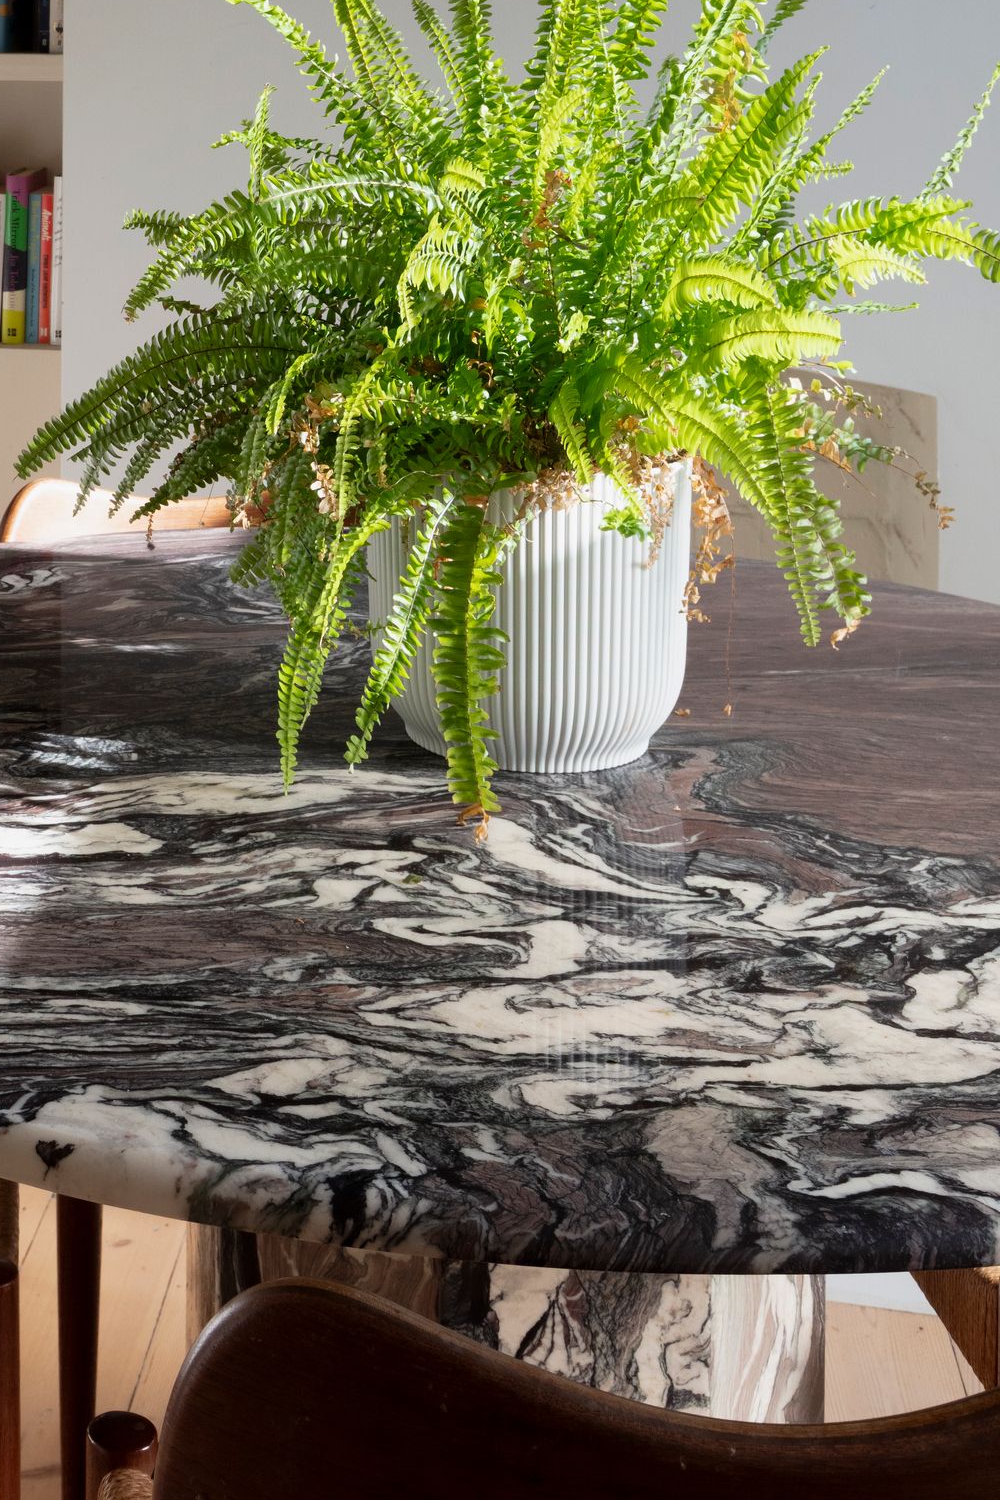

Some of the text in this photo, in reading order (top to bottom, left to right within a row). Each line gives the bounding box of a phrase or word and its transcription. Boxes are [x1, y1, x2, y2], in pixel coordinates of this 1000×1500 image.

[10, 190, 21, 249] Trick Mirror
[41, 209, 52, 241] Animals
